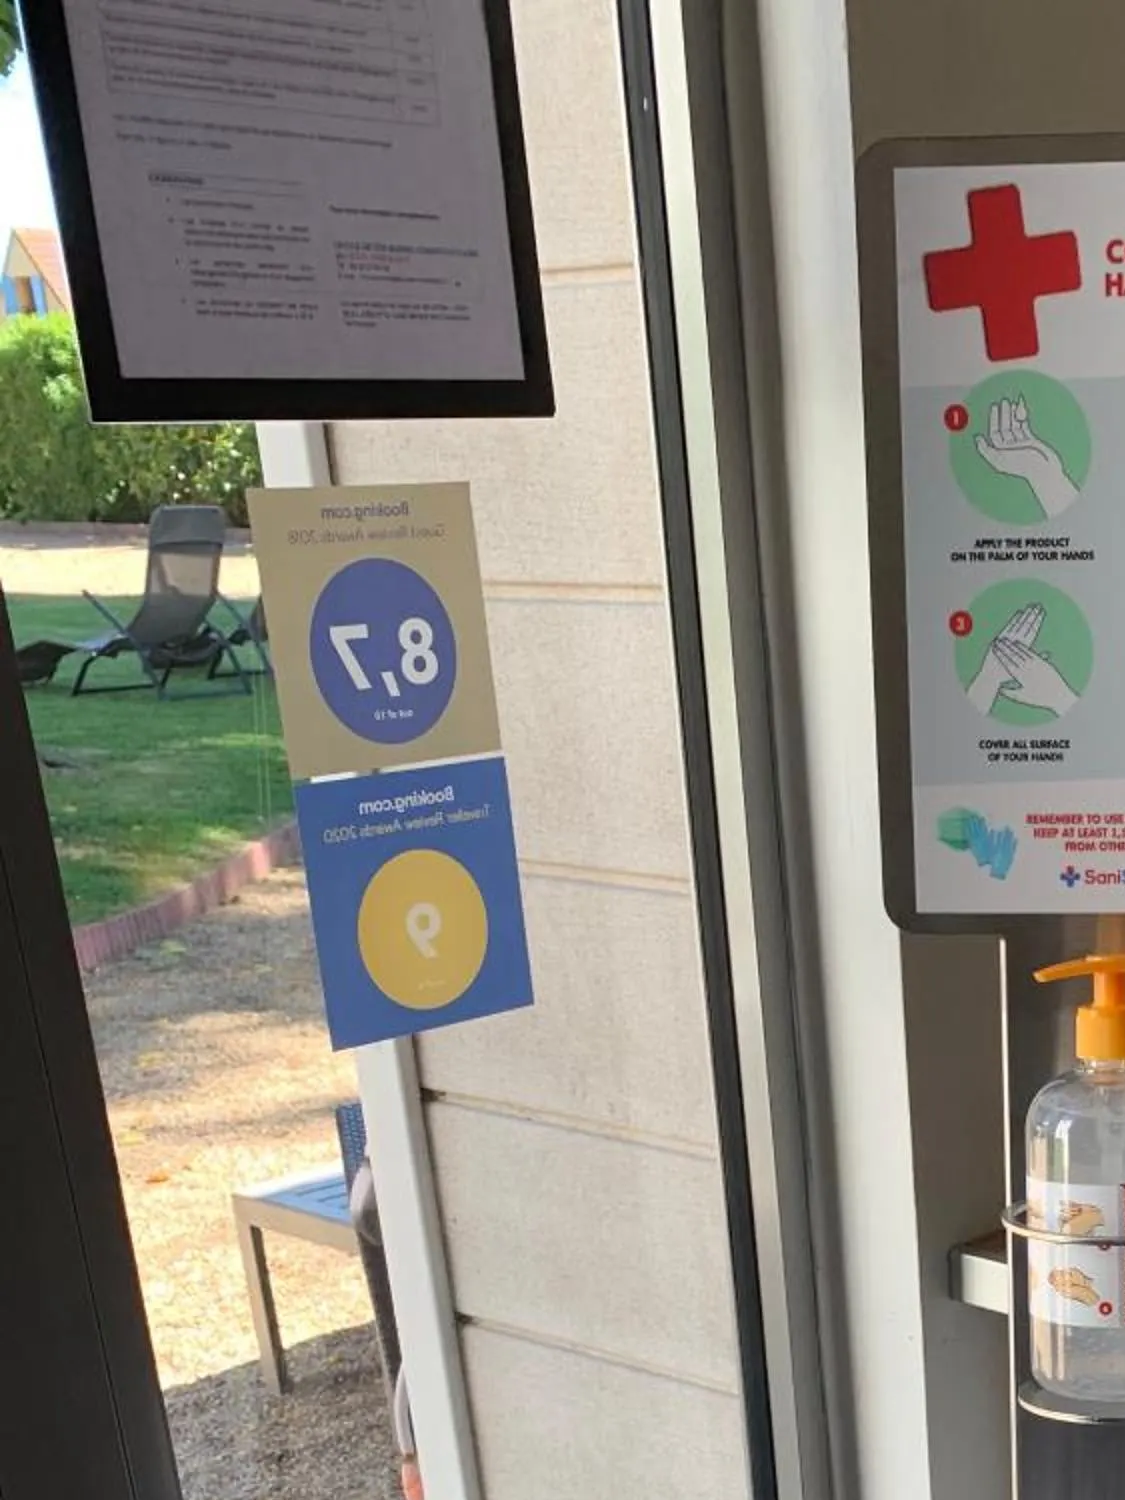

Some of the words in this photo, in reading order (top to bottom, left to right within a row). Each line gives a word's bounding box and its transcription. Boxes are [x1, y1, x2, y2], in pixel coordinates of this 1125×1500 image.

[974, 538, 1002, 549] APPLY
[1004, 537, 1022, 548] THE
[1025, 537, 1070, 548] PRODUCT
[951, 551, 967, 561] ON
[968, 551, 985, 561] THE
[988, 551, 1014, 561] PALM
[1016, 551, 1028, 561] OF
[1032, 551, 1058, 560] YOUR
[1061, 550, 1095, 560] HANDS
[979, 739, 1010, 749] COVER
[1012, 739, 1027, 749] ALL
[1030, 739, 1071, 749] SURFACE
[988, 752, 1000, 761] OF
[1003, 752, 1029, 761] YOUR
[1031, 752, 1064, 761] HANDS
[1026, 813, 1084, 825] REMEMBER
[1086, 813, 1101, 825] TO
[1104, 813, 1125, 824] USE
[1033, 827, 1059, 839] KEEP
[1061, 827, 1075, 838] AT
[1077, 827, 1108, 838] LEAST
[1065, 841, 1095, 852] FROM
